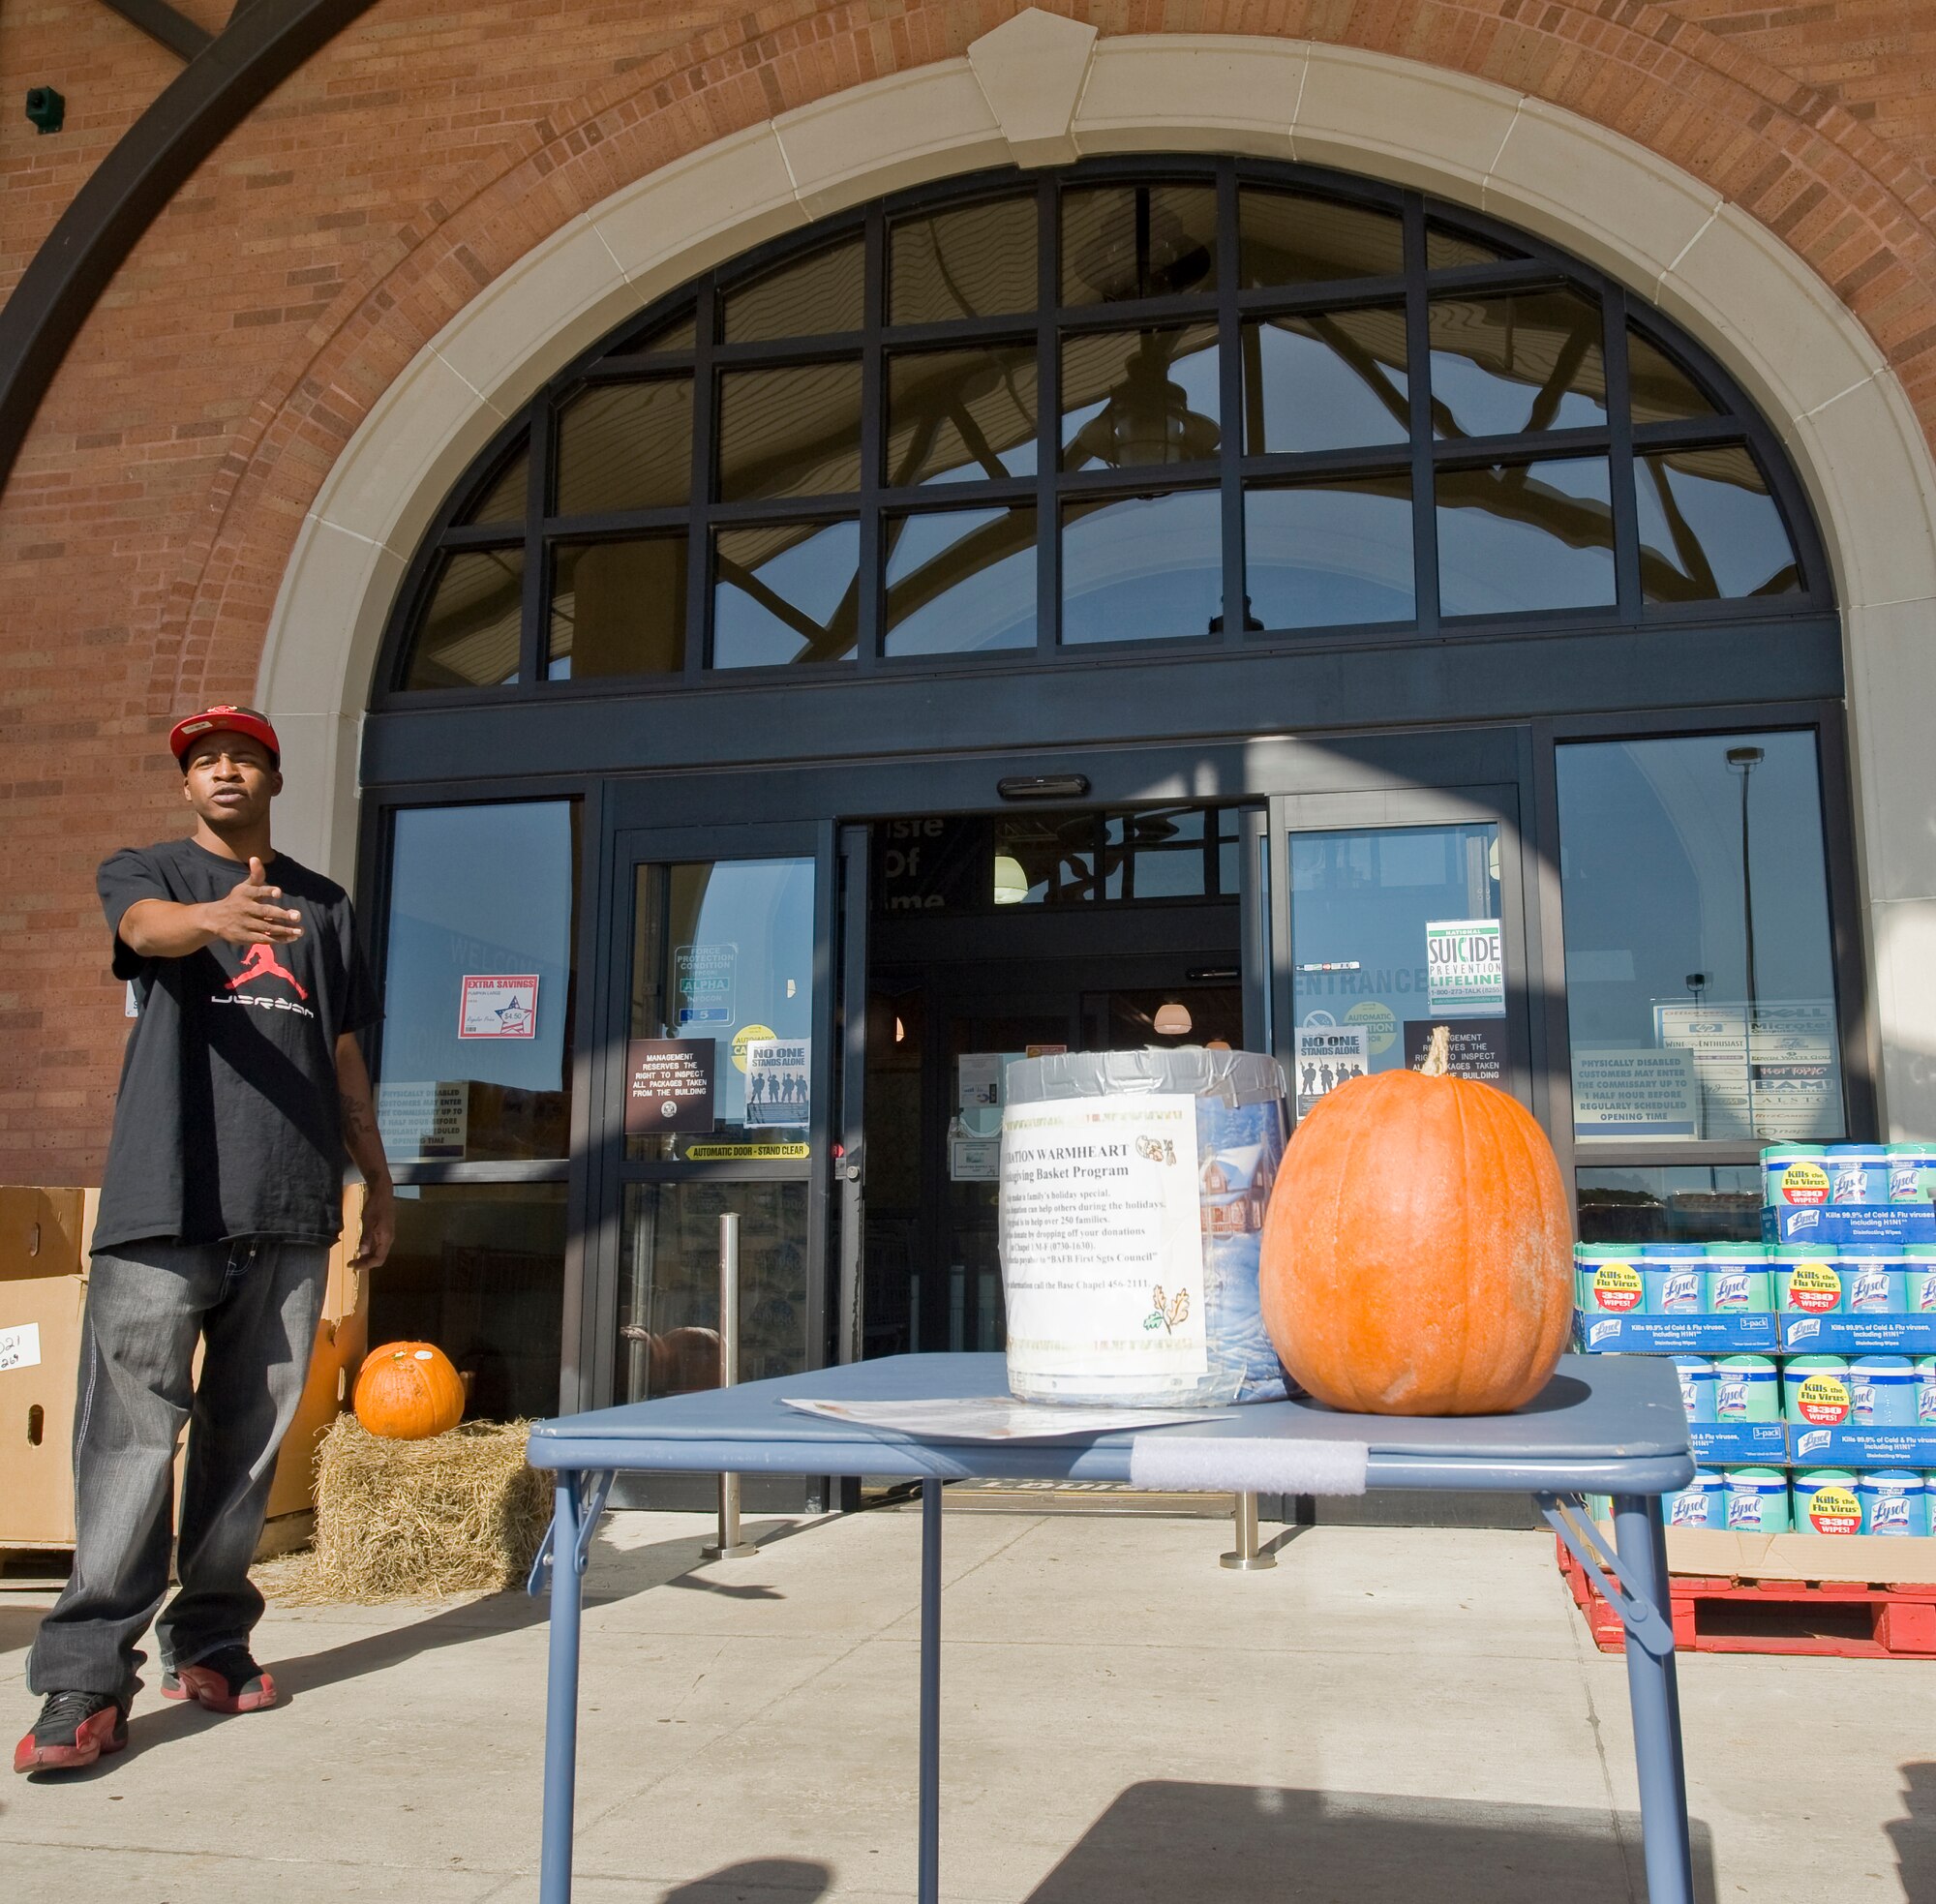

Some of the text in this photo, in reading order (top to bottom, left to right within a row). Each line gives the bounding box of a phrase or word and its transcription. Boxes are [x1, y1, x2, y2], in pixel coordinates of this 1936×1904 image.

[1429, 936, 1499, 964] SUICIDE
[1430, 963, 1501, 975] PREVENTION
[497, 980, 534, 988] SAVINGS
[685, 980, 725, 990] ALPHA
[1295, 968, 1429, 996] ENTRANCE
[1431, 975, 1501, 986] LIFELINE
[700, 1011, 709, 1019] 5
[1302, 1036, 1359, 1047] NO ONE
[753, 1048, 773, 1058] NO
[776, 1048, 804, 1058] ONE
[1301, 1046, 1360, 1056] STANDS ALONE
[647, 1053, 694, 1062] MANAGEMENT
[752, 1058, 781, 1067] STANDS
[1582, 1058, 1680, 1068] PHYSICALLY DISABLED
[1579, 1070, 1632, 1078] CUSTOMERS
[1657, 1069, 1685, 1077] ENTER
[693, 1146, 803, 1157] AUTOMATIC DOOR STAND CLEAR
[1037, 1144, 1130, 1161] WARMHEART
[1037, 1165, 1129, 1181] Basket Program
[1891, 1170, 1917, 1191] Lysol
[1051, 1191, 1076, 1200] holiday
[1080, 1189, 1110, 1199] special.
[1039, 1204, 1052, 1214] help
[1078, 1202, 1106, 1212] during
[1109, 1201, 1123, 1210] the
[1125, 1200, 1165, 1211] holidays.
[1031, 1215, 1110, 1226] help 250 families.
[1036, 1229, 1065, 1239] dropping
[1080, 1229, 1099, 1238] your
[1102, 1227, 1145, 1236] donations
[1096, 1254, 1114, 1264] Sgts
[1797, 1271, 1820, 1280] Kills
[1034, 1281, 1044, 1289] call
[1057, 1281, 1074, 1289] Base
[1076, 1280, 1104, 1290] Chapel
[1665, 1276, 1697, 1298] Lysol
[1716, 1278, 1748, 1299] Lysol
[1854, 1277, 1887, 1298] Lysol
[1741, 1319, 1768, 1328] 3-pack
[1804, 1383, 1828, 1392] Kills
[1718, 1386, 1745, 1406] Lysol
[1806, 1405, 1841, 1414] 330
[1755, 1429, 1779, 1438] 3-pack
[1816, 1496, 1839, 1504] Kills
[1673, 1497, 1706, 1517] Lysol
[1730, 1498, 1760, 1519] Lysol
[1873, 1500, 1906, 1521] Lysol
[1818, 1518, 1855, 1526] 330
